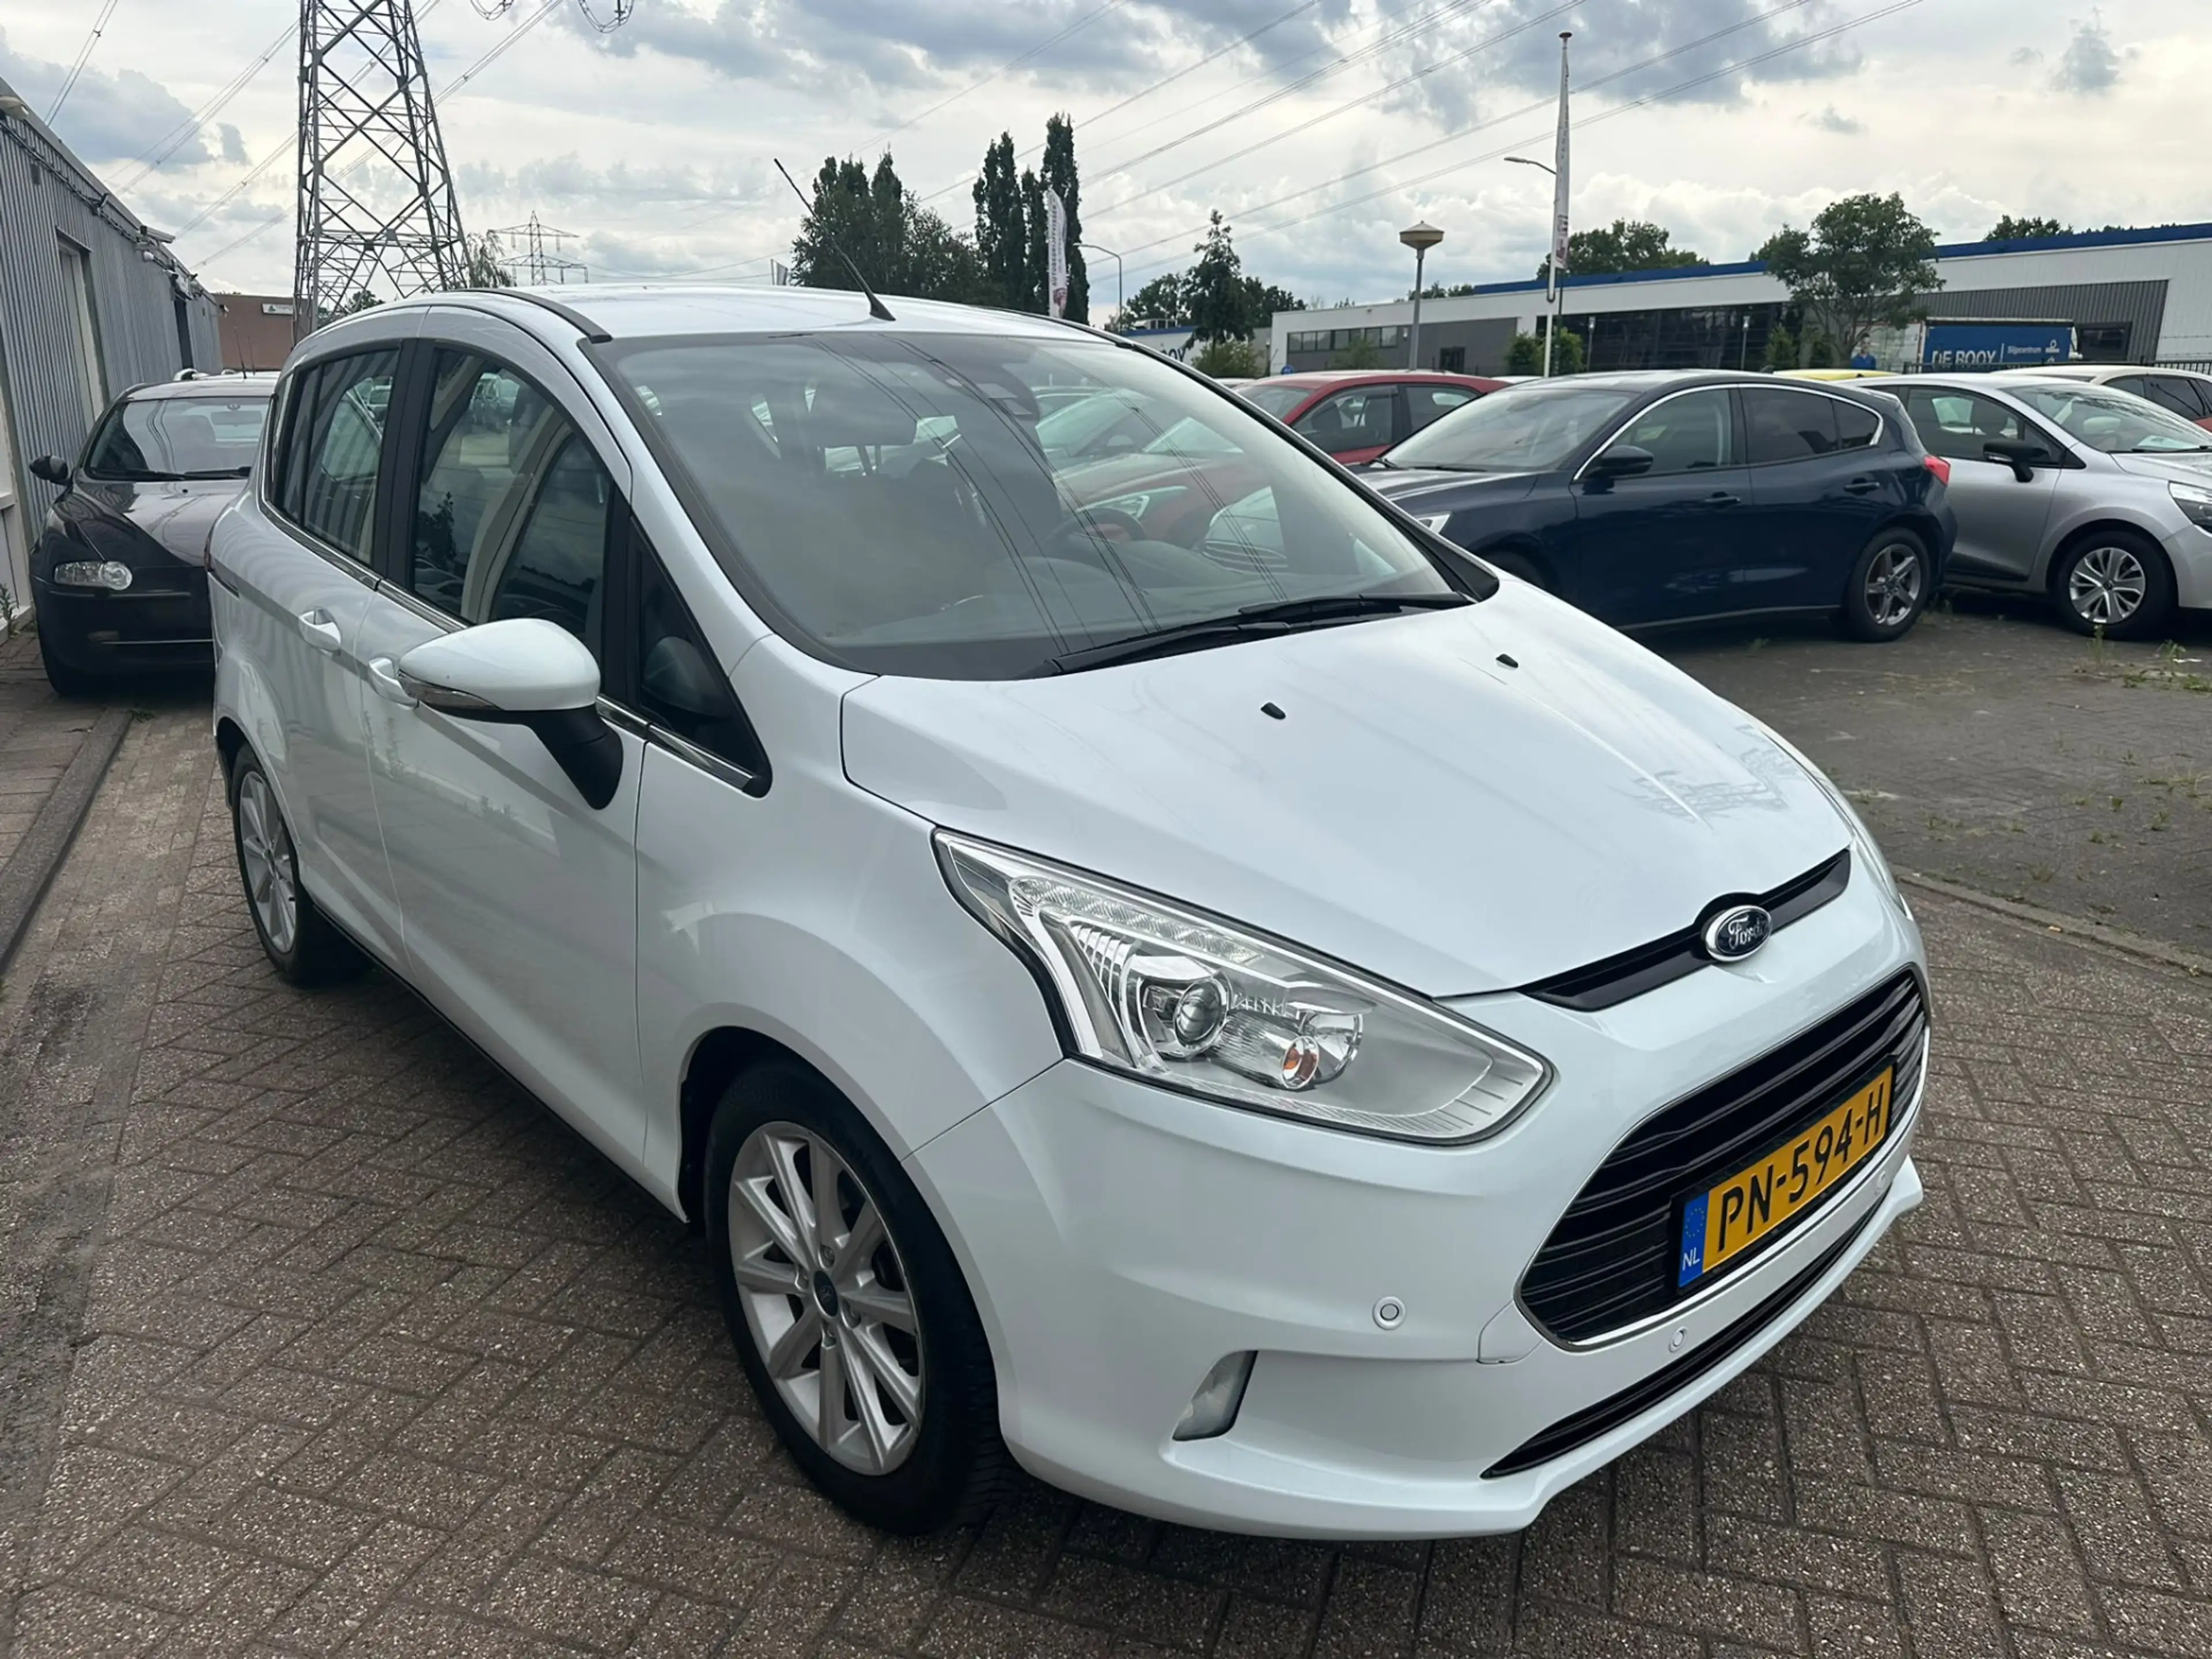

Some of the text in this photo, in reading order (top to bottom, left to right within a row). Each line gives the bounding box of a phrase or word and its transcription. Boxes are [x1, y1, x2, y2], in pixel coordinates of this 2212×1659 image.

[1931, 350, 1952, 367] DE
[1728, 914, 1764, 950] Ford
[1718, 1081, 1884, 1252] PN-594-H
[1682, 1247, 1700, 1271] NL
